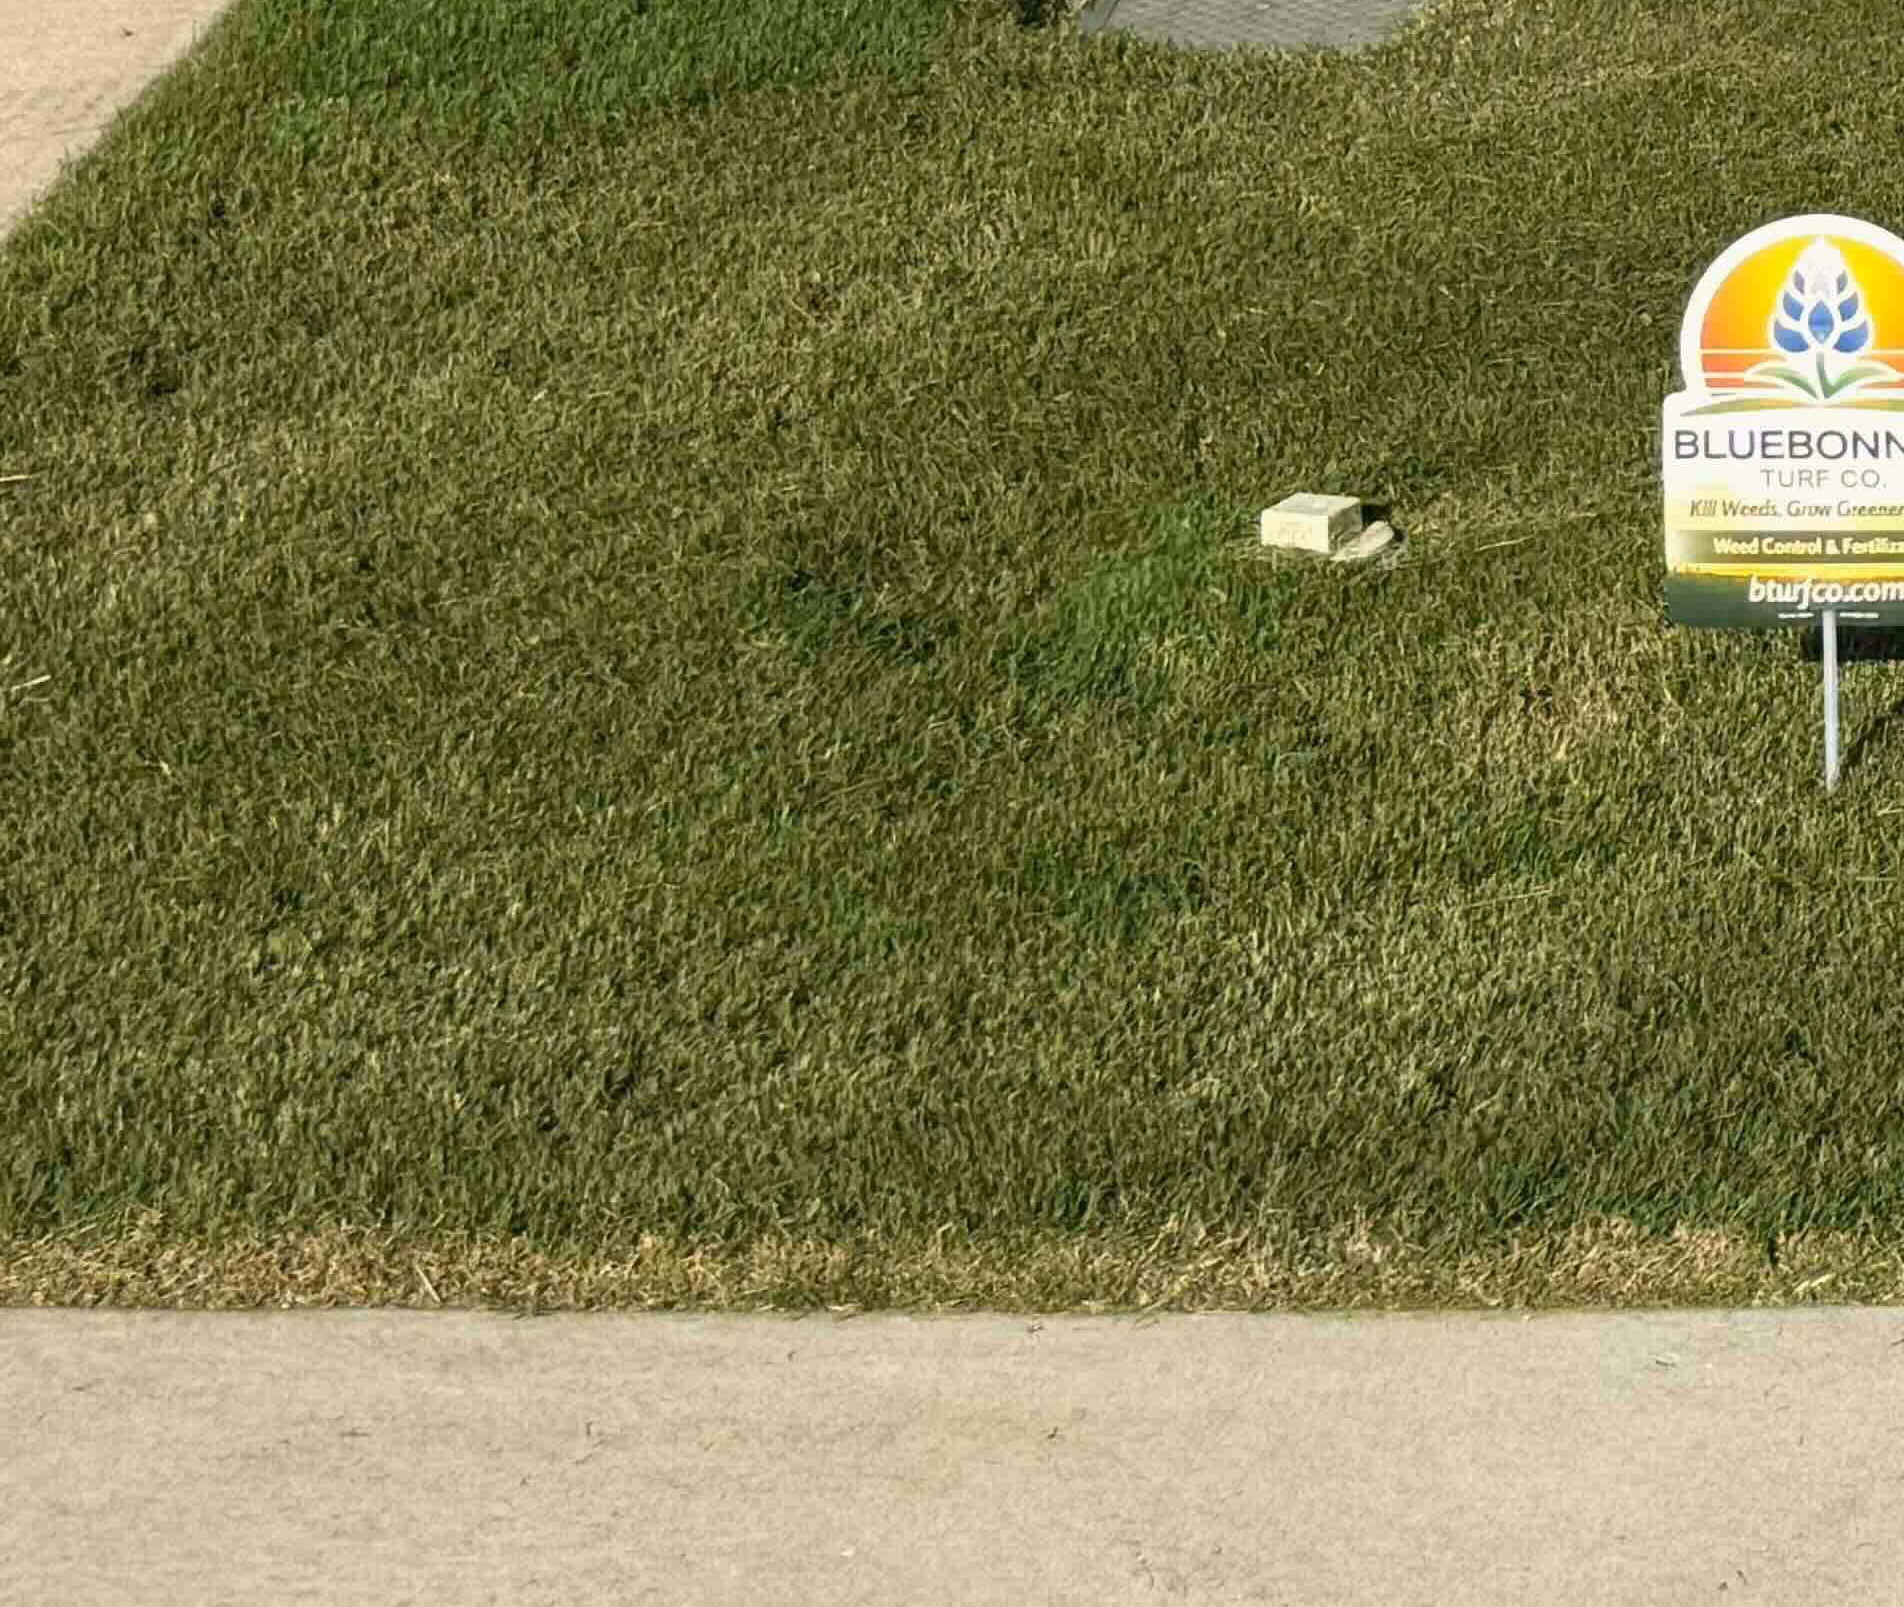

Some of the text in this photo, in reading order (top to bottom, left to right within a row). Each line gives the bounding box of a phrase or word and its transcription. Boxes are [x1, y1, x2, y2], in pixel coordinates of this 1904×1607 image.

[1760, 469, 1887, 489] TURF CO.
[1690, 499, 1718, 517] Kill
[1787, 499, 1832, 517] Grow
[1838, 500, 1904, 516] Greener
[1713, 536, 1759, 554] Weed
[1761, 536, 1822, 554] Control
